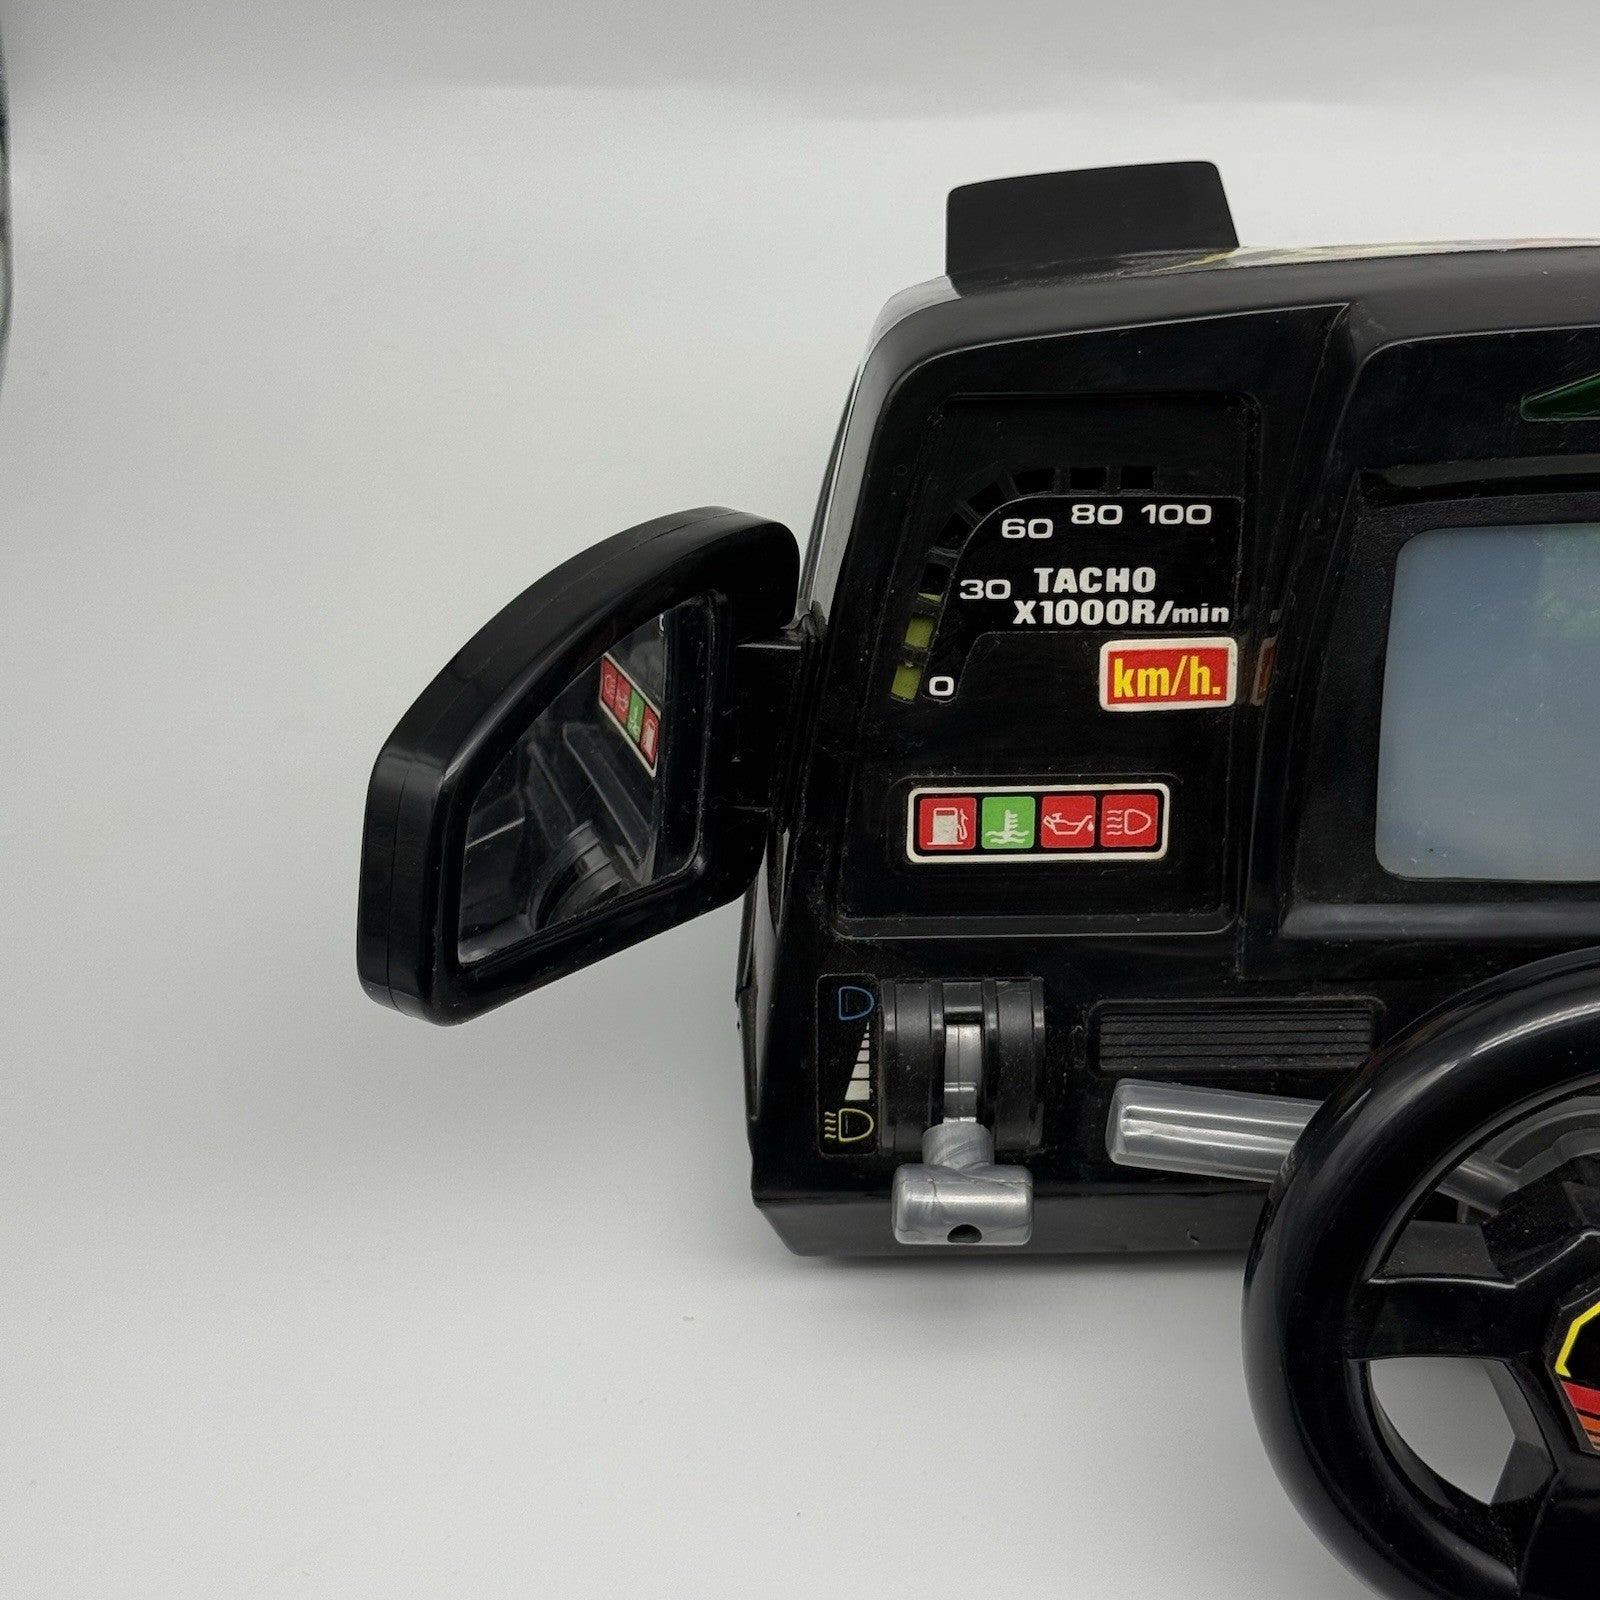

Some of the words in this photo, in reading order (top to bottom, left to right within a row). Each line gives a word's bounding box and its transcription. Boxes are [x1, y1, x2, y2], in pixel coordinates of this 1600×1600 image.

[1002, 519, 1053, 538] 60
[1071, 504, 1122, 524] 80
[1141, 505, 1211, 524] 100
[960, 579, 1011, 599] 30
[1034, 567, 1156, 593] TACHO
[1013, 599, 1229, 625] X1000R/min
[929, 676, 954, 696] 0
[1114, 656, 1220, 697] km/h.
